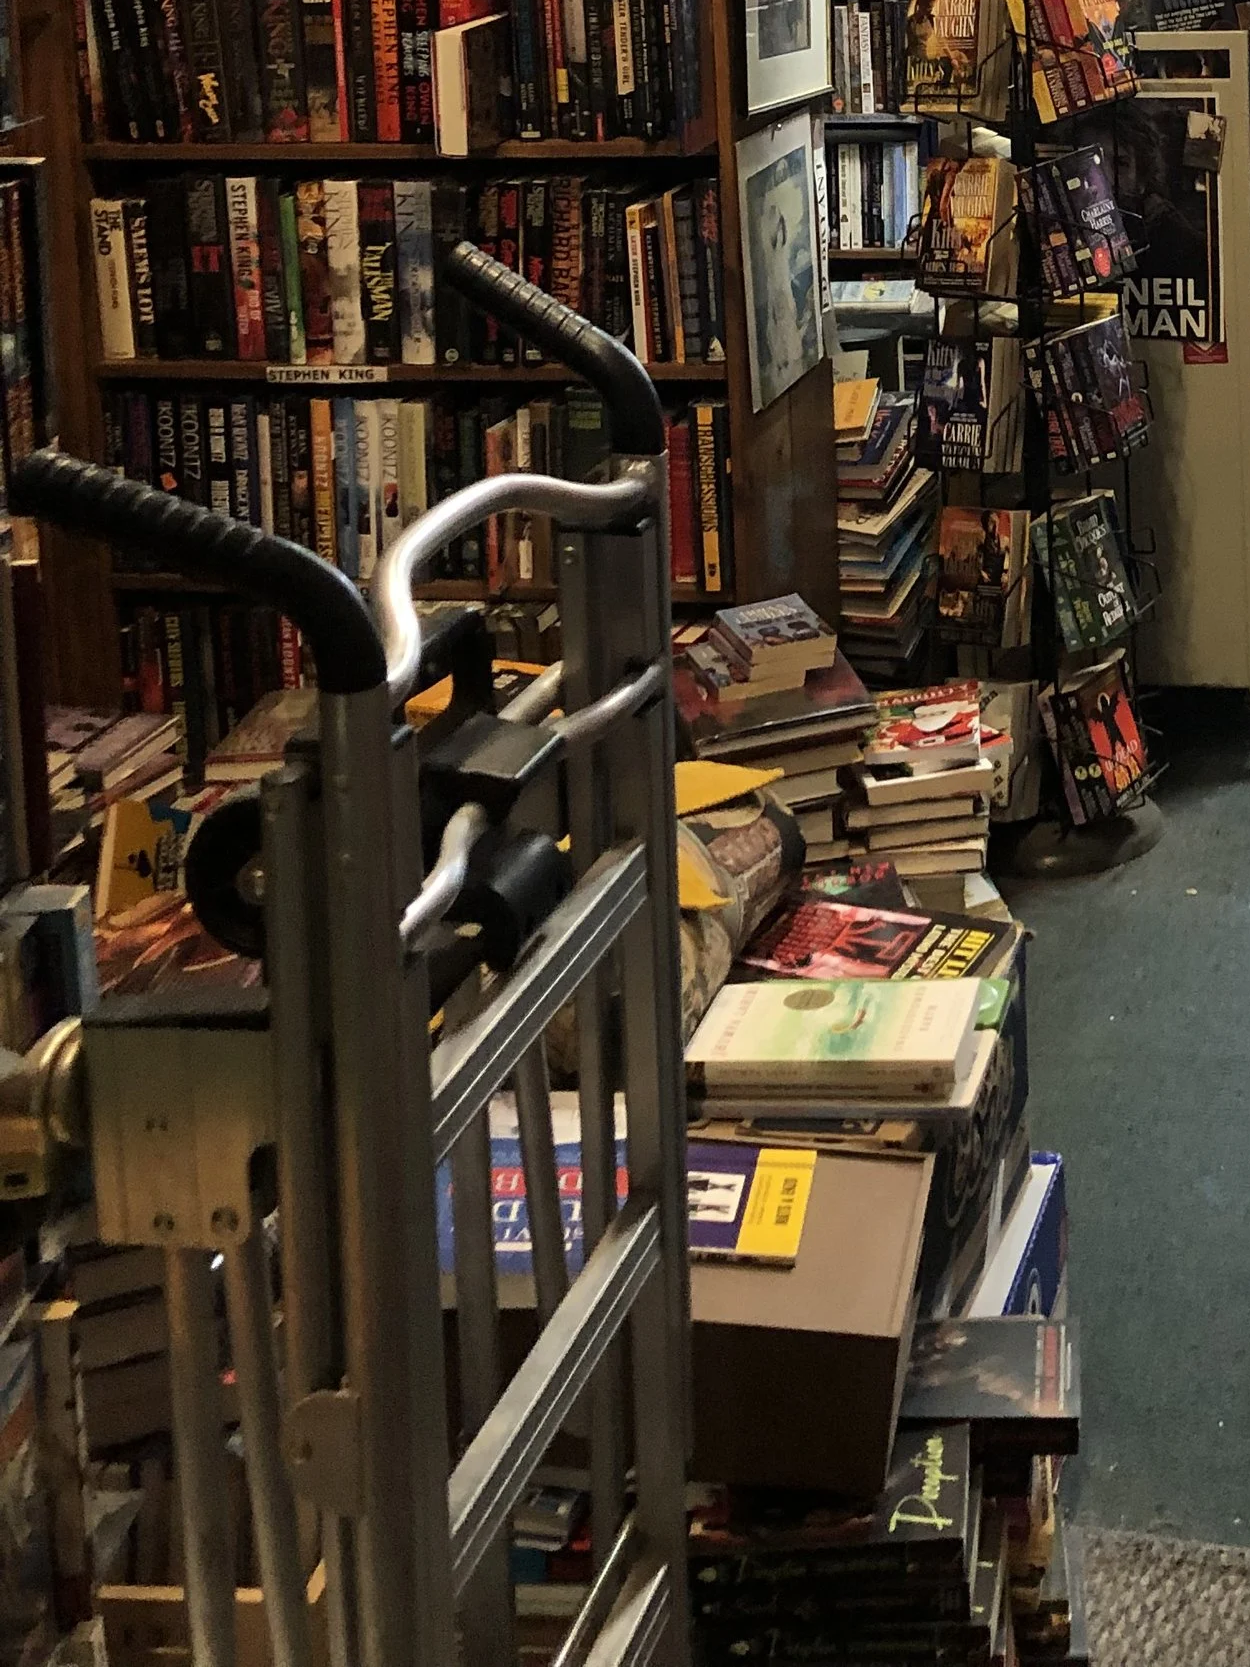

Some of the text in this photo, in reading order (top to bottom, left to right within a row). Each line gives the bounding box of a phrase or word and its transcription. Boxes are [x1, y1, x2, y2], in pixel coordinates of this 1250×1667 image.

[860, 15, 870, 53] FANTASY
[933, 15, 976, 38] VAUGHN
[384, 62, 399, 106] KING
[94, 209, 112, 256] STAND
[108, 209, 122, 231] THE
[230, 184, 253, 276] STEPHEN KING
[1089, 215, 1114, 228] HARRIS
[362, 242, 392, 322] TALISMAN
[1124, 278, 1206, 308] NEIL
[138, 288, 155, 324] LOT
[268, 368, 374, 382] STEPHEN KING
[943, 423, 982, 447] CARRIE
